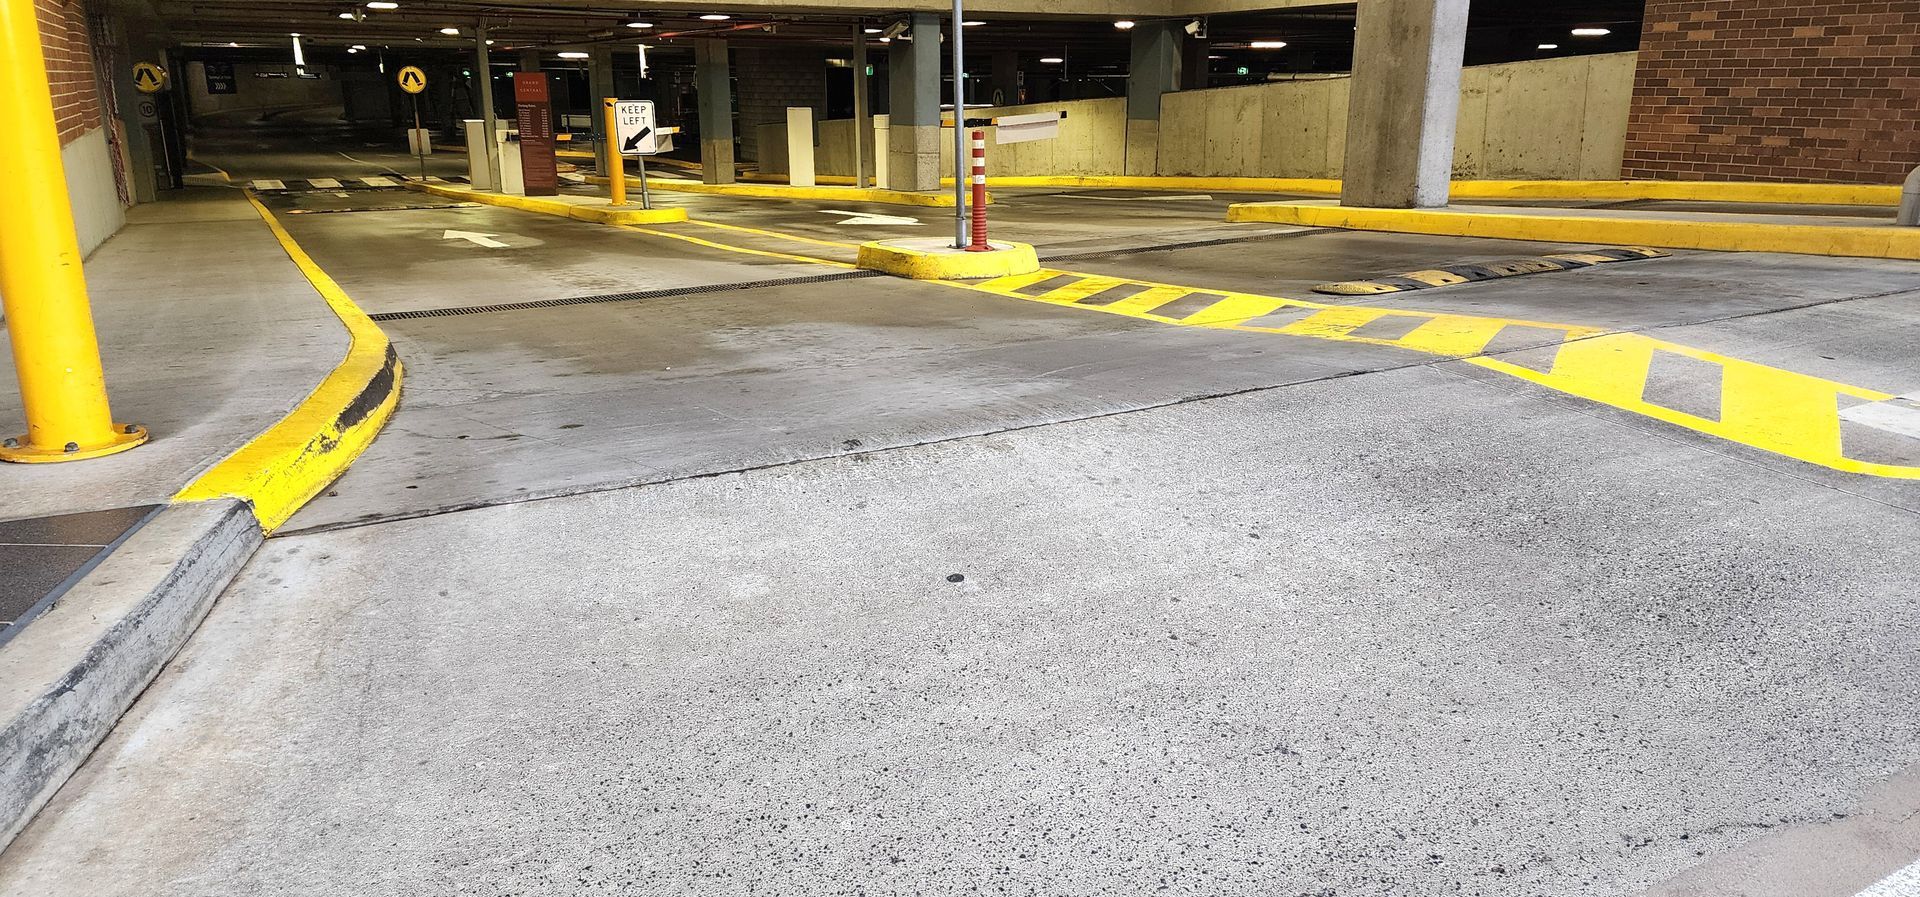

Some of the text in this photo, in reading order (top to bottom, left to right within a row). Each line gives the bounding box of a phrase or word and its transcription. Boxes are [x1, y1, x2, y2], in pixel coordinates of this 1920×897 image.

[142, 103, 152, 114] 10
[621, 105, 647, 114] KEEP
[623, 116, 647, 125] LEFT
